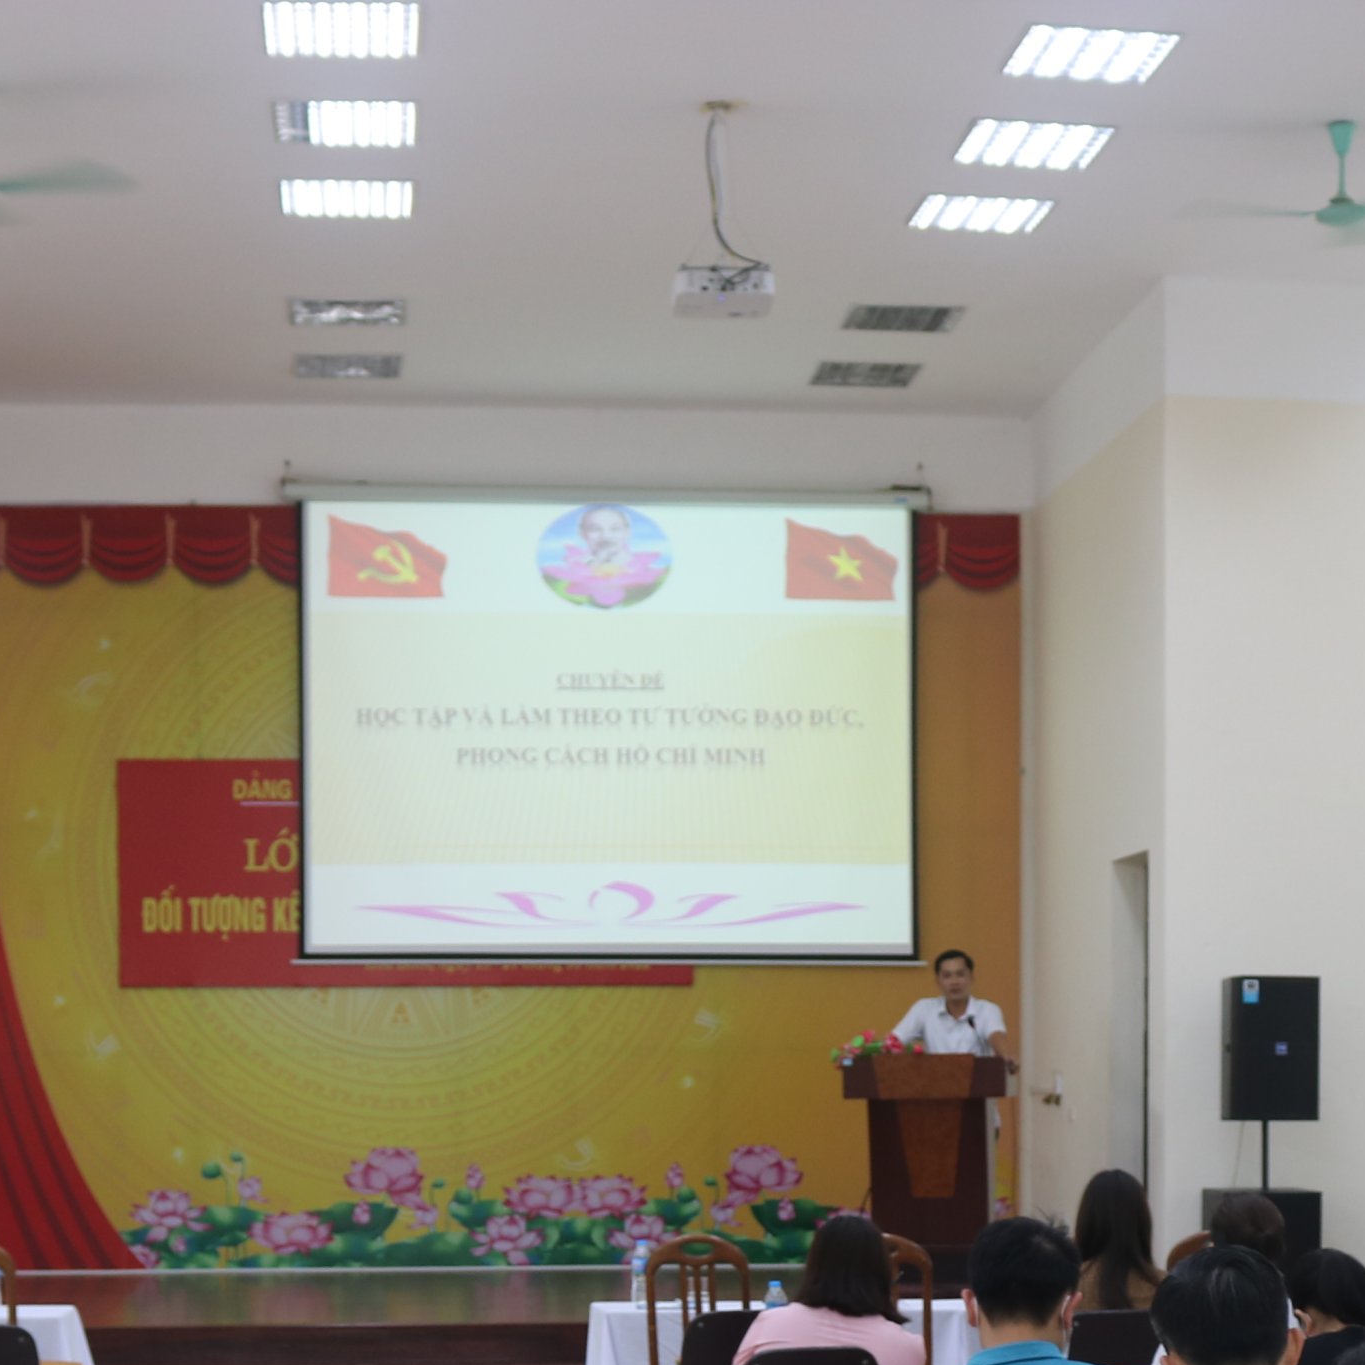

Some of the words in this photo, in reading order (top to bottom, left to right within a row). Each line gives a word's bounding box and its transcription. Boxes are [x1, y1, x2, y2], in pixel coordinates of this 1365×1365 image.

[356, 706, 403, 728] HỌC
[557, 708, 622, 727] THEO
[456, 746, 537, 766] PHONG
[544, 743, 609, 766] CÁCH
[703, 747, 766, 767] MINH
[243, 827, 300, 873] LỚ
[141, 884, 183, 934] ĐỐI
[187, 893, 267, 942] TƯỢNG
